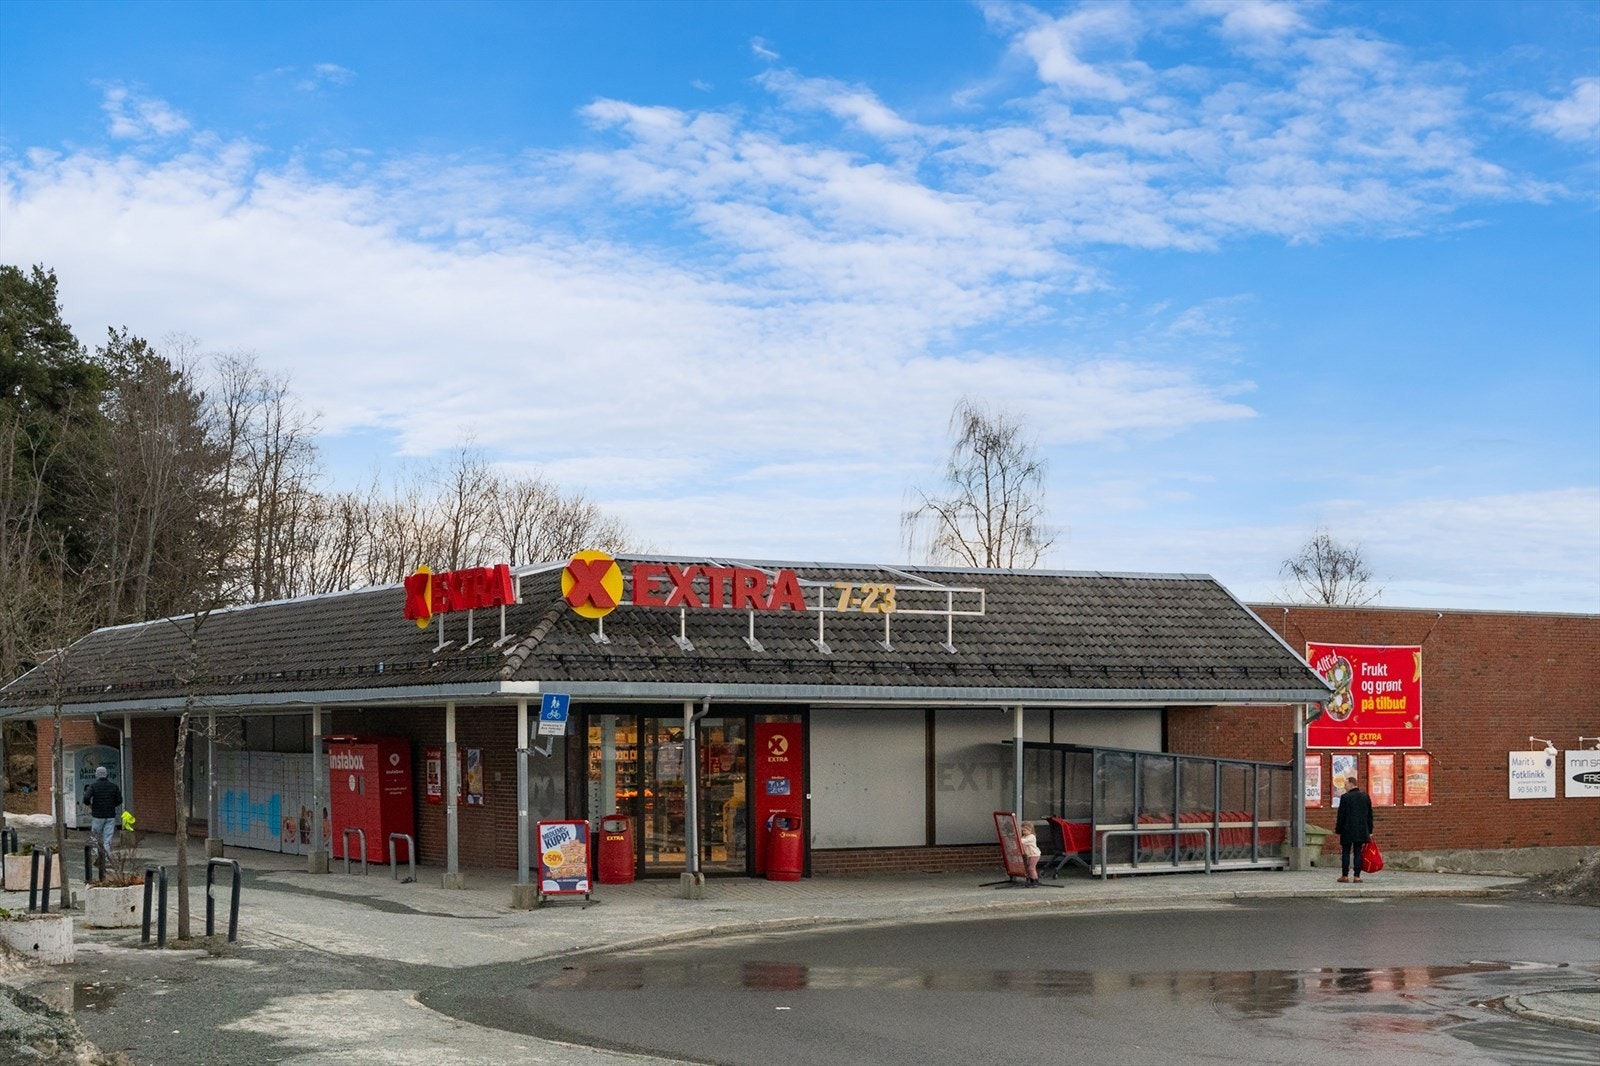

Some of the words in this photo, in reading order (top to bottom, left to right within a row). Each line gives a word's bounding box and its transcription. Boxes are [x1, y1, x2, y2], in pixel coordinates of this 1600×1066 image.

[431, 564, 515, 613] EXTRA
[632, 564, 807, 611] EXTRA
[835, 581, 896, 613] 7-23
[1316, 649, 1338, 672] Alltid
[1361, 662, 1388, 677] Frukt
[1361, 681, 1374, 695] og
[1375, 679, 1402, 695] grønt
[1361, 696, 1374, 712] på
[1376, 696, 1406, 710] tilbud
[1359, 732, 1382, 741] EXTRA
[329, 749, 364, 770] instabox
[936, 762, 1014, 792] EXTR
[1511, 770, 1545, 778] Fotklinikk
[544, 831, 571, 849] KUPP!
